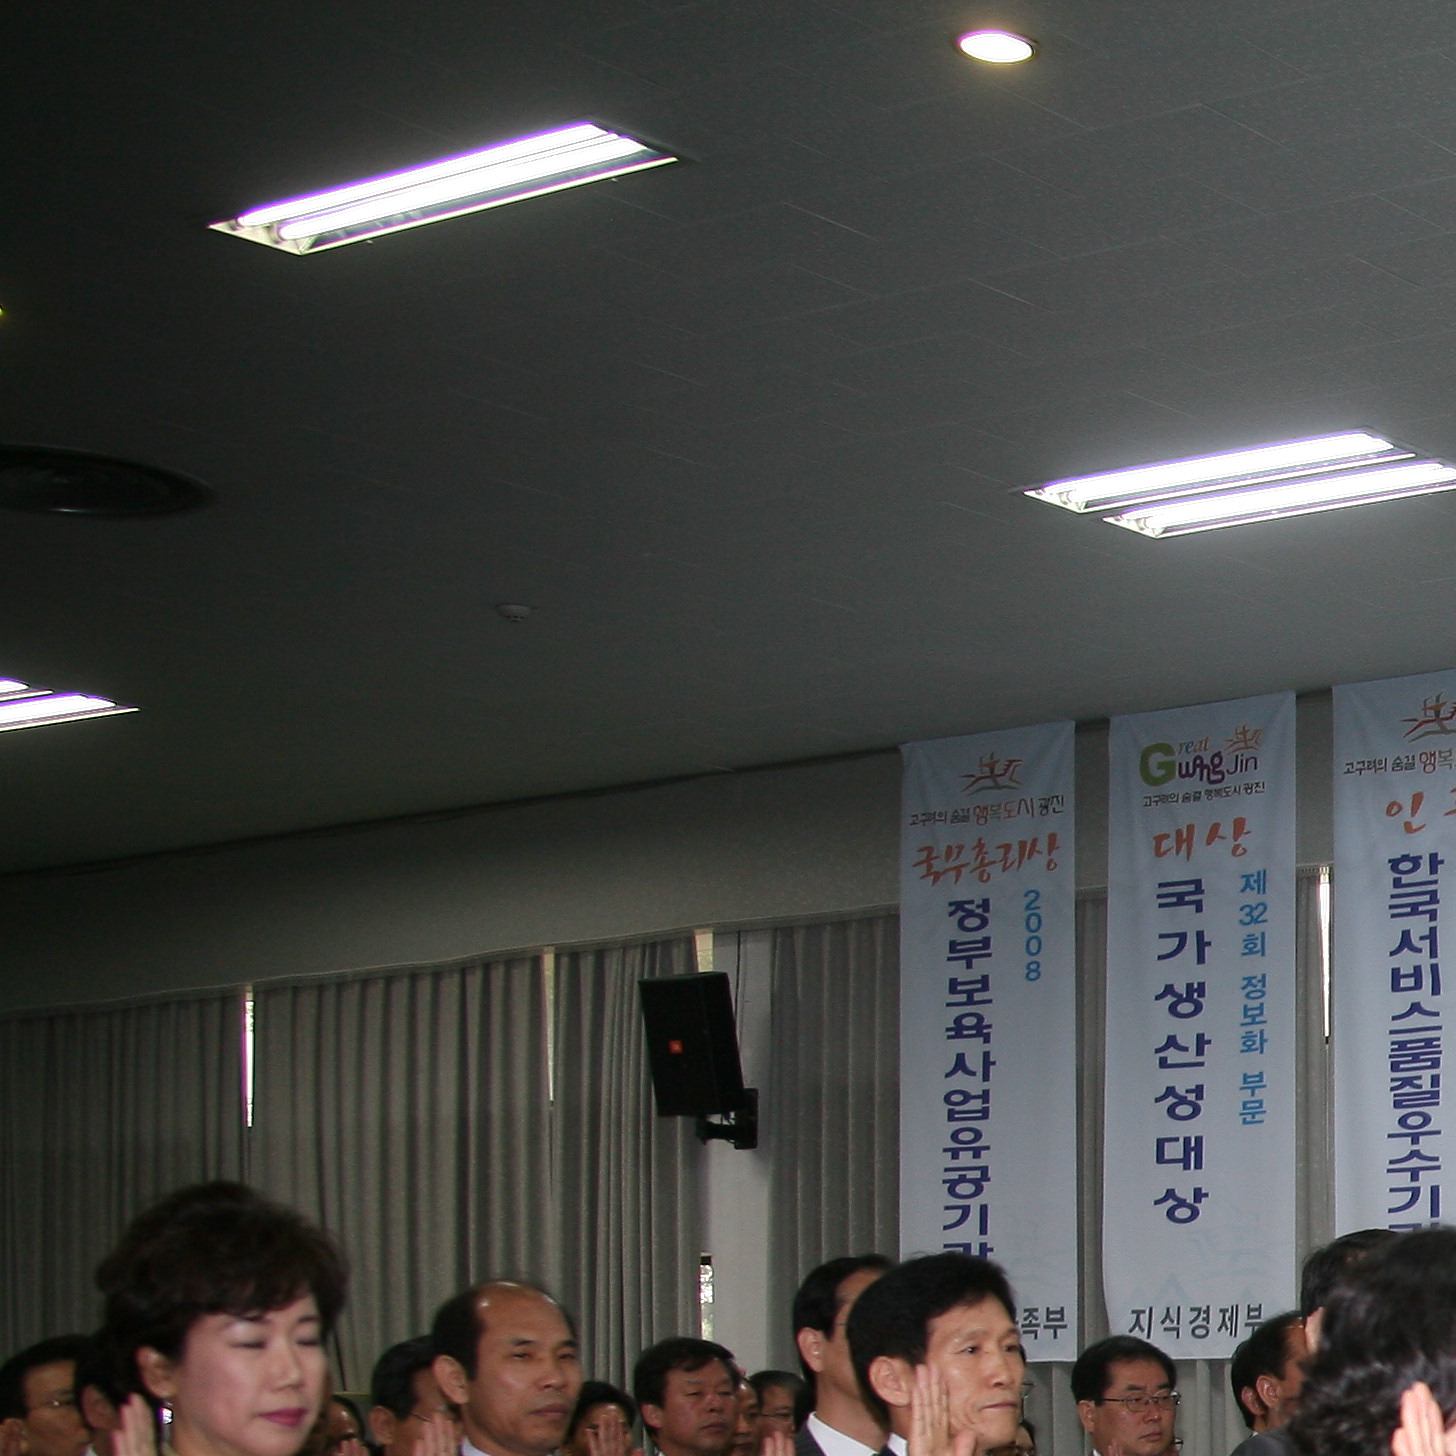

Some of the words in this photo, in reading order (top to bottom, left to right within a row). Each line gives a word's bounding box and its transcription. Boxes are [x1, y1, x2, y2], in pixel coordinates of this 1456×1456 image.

[1343, 757, 1387, 776] 고구려의
[1391, 755, 1416, 772] 숨결
[912, 832, 1060, 887] 국무총리상
[1153, 817, 1251, 861] 대상
[1024, 889, 1042, 981] 2008
[1240, 869, 1268, 957] 제32회
[1240, 973, 1268, 1054] 정보화
[1386, 852, 1445, 1231] 한국서비스품질우수기
[1154, 878, 1212, 1225] 국가생산성대상
[1239, 1071, 1267, 1125] 부문
[1128, 1303, 1264, 1340] 지식경제부
